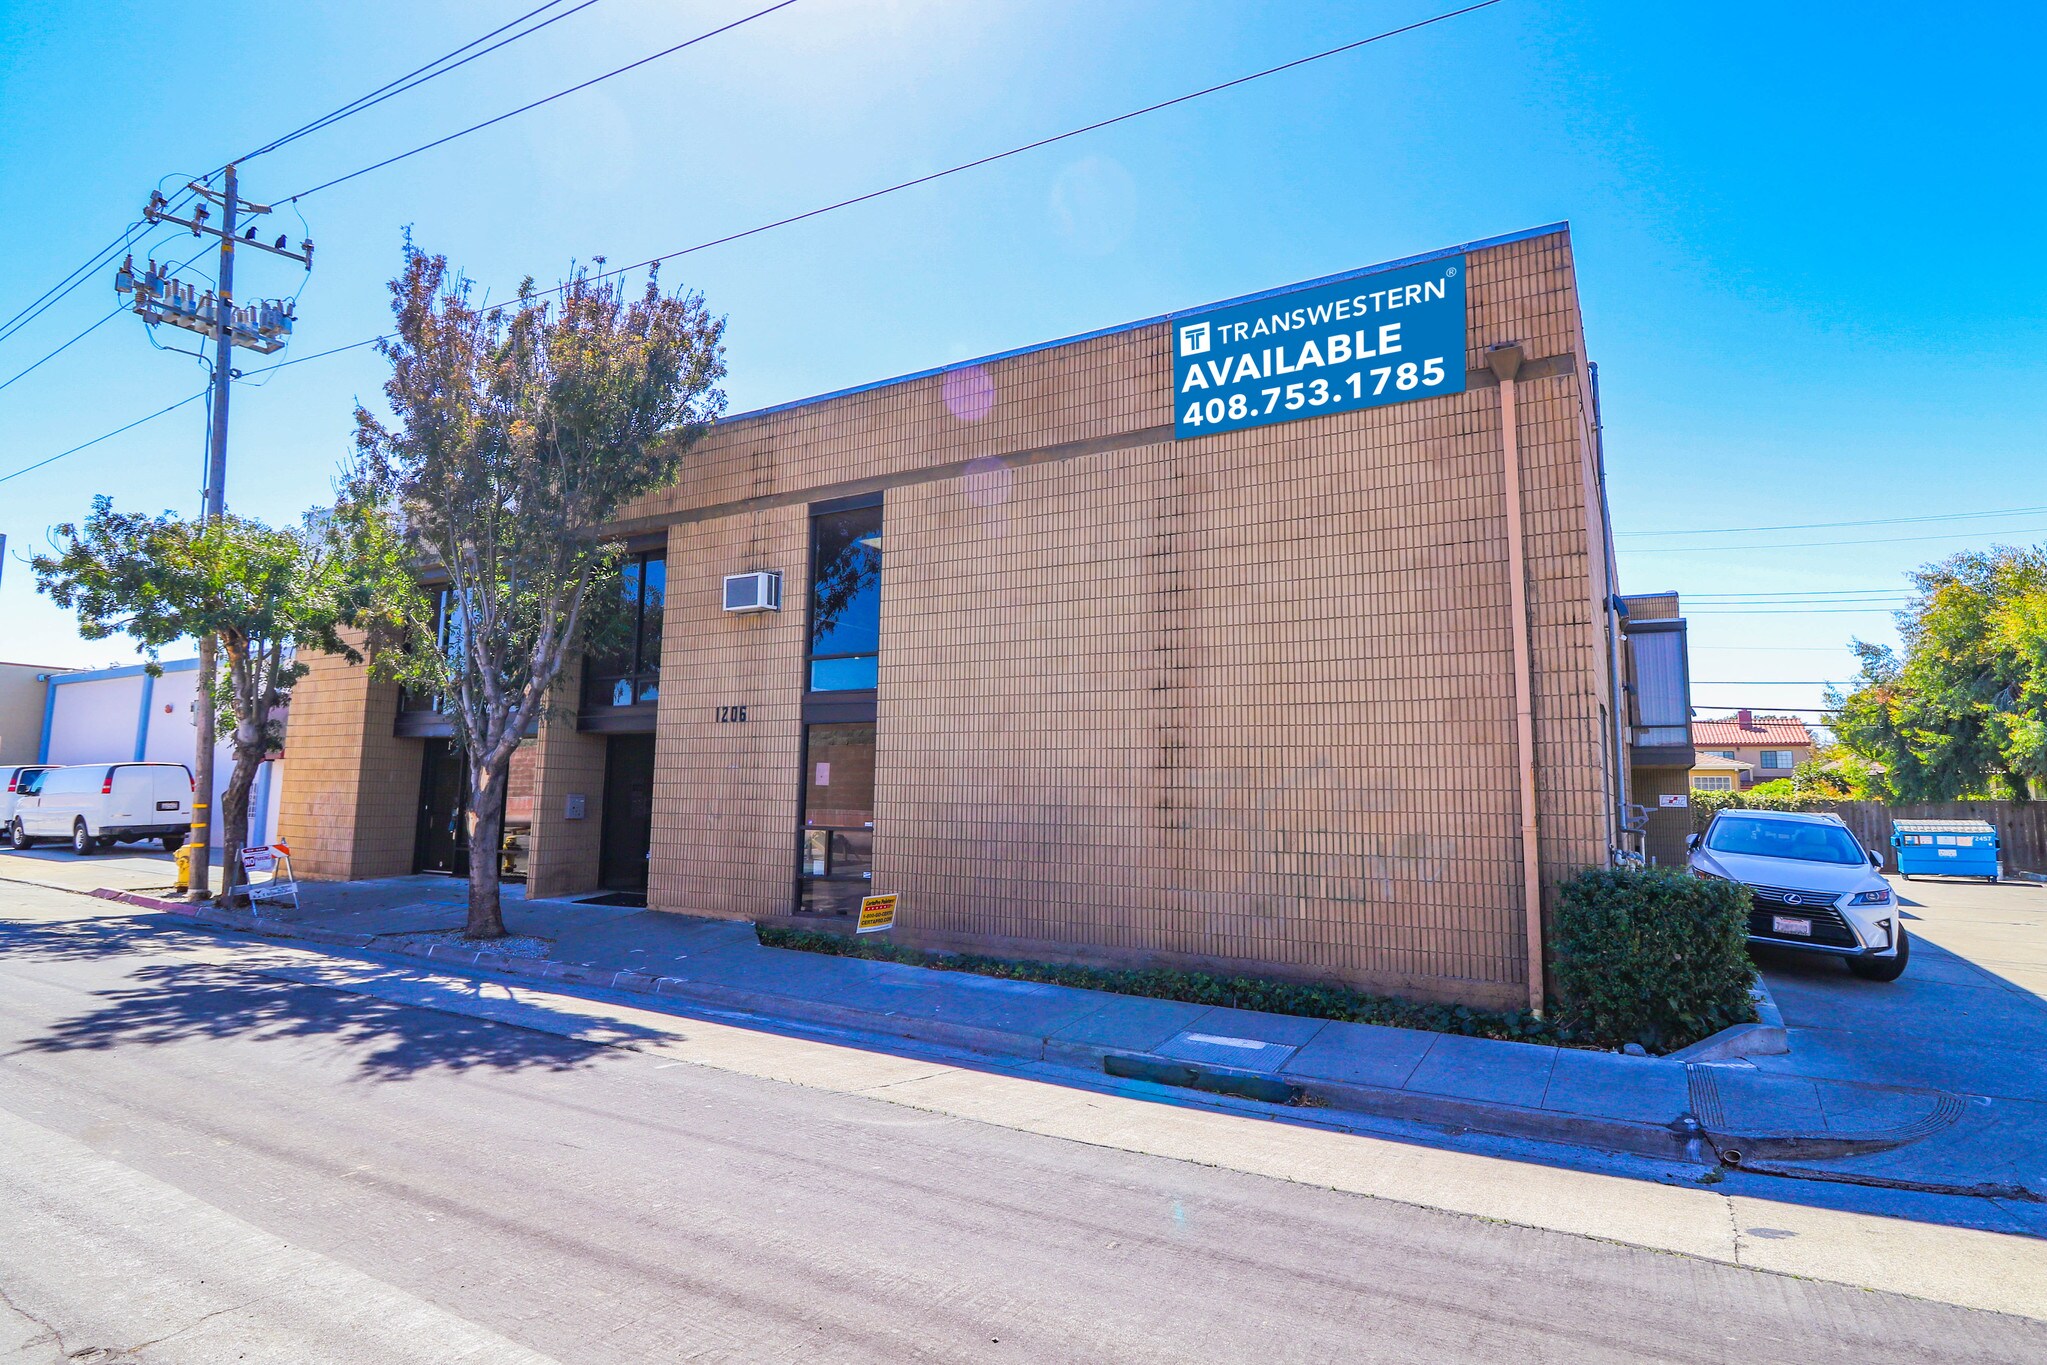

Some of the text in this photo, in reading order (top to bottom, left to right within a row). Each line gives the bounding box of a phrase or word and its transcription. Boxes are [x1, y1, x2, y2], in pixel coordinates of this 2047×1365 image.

[1217, 278, 1446, 345] TRANSWESTERN
[1181, 322, 1402, 393] AVAILABLE
[1182, 356, 1446, 427] 408.753.1785
[715, 705, 747, 723] 1206
[245, 858, 255, 867] NO
